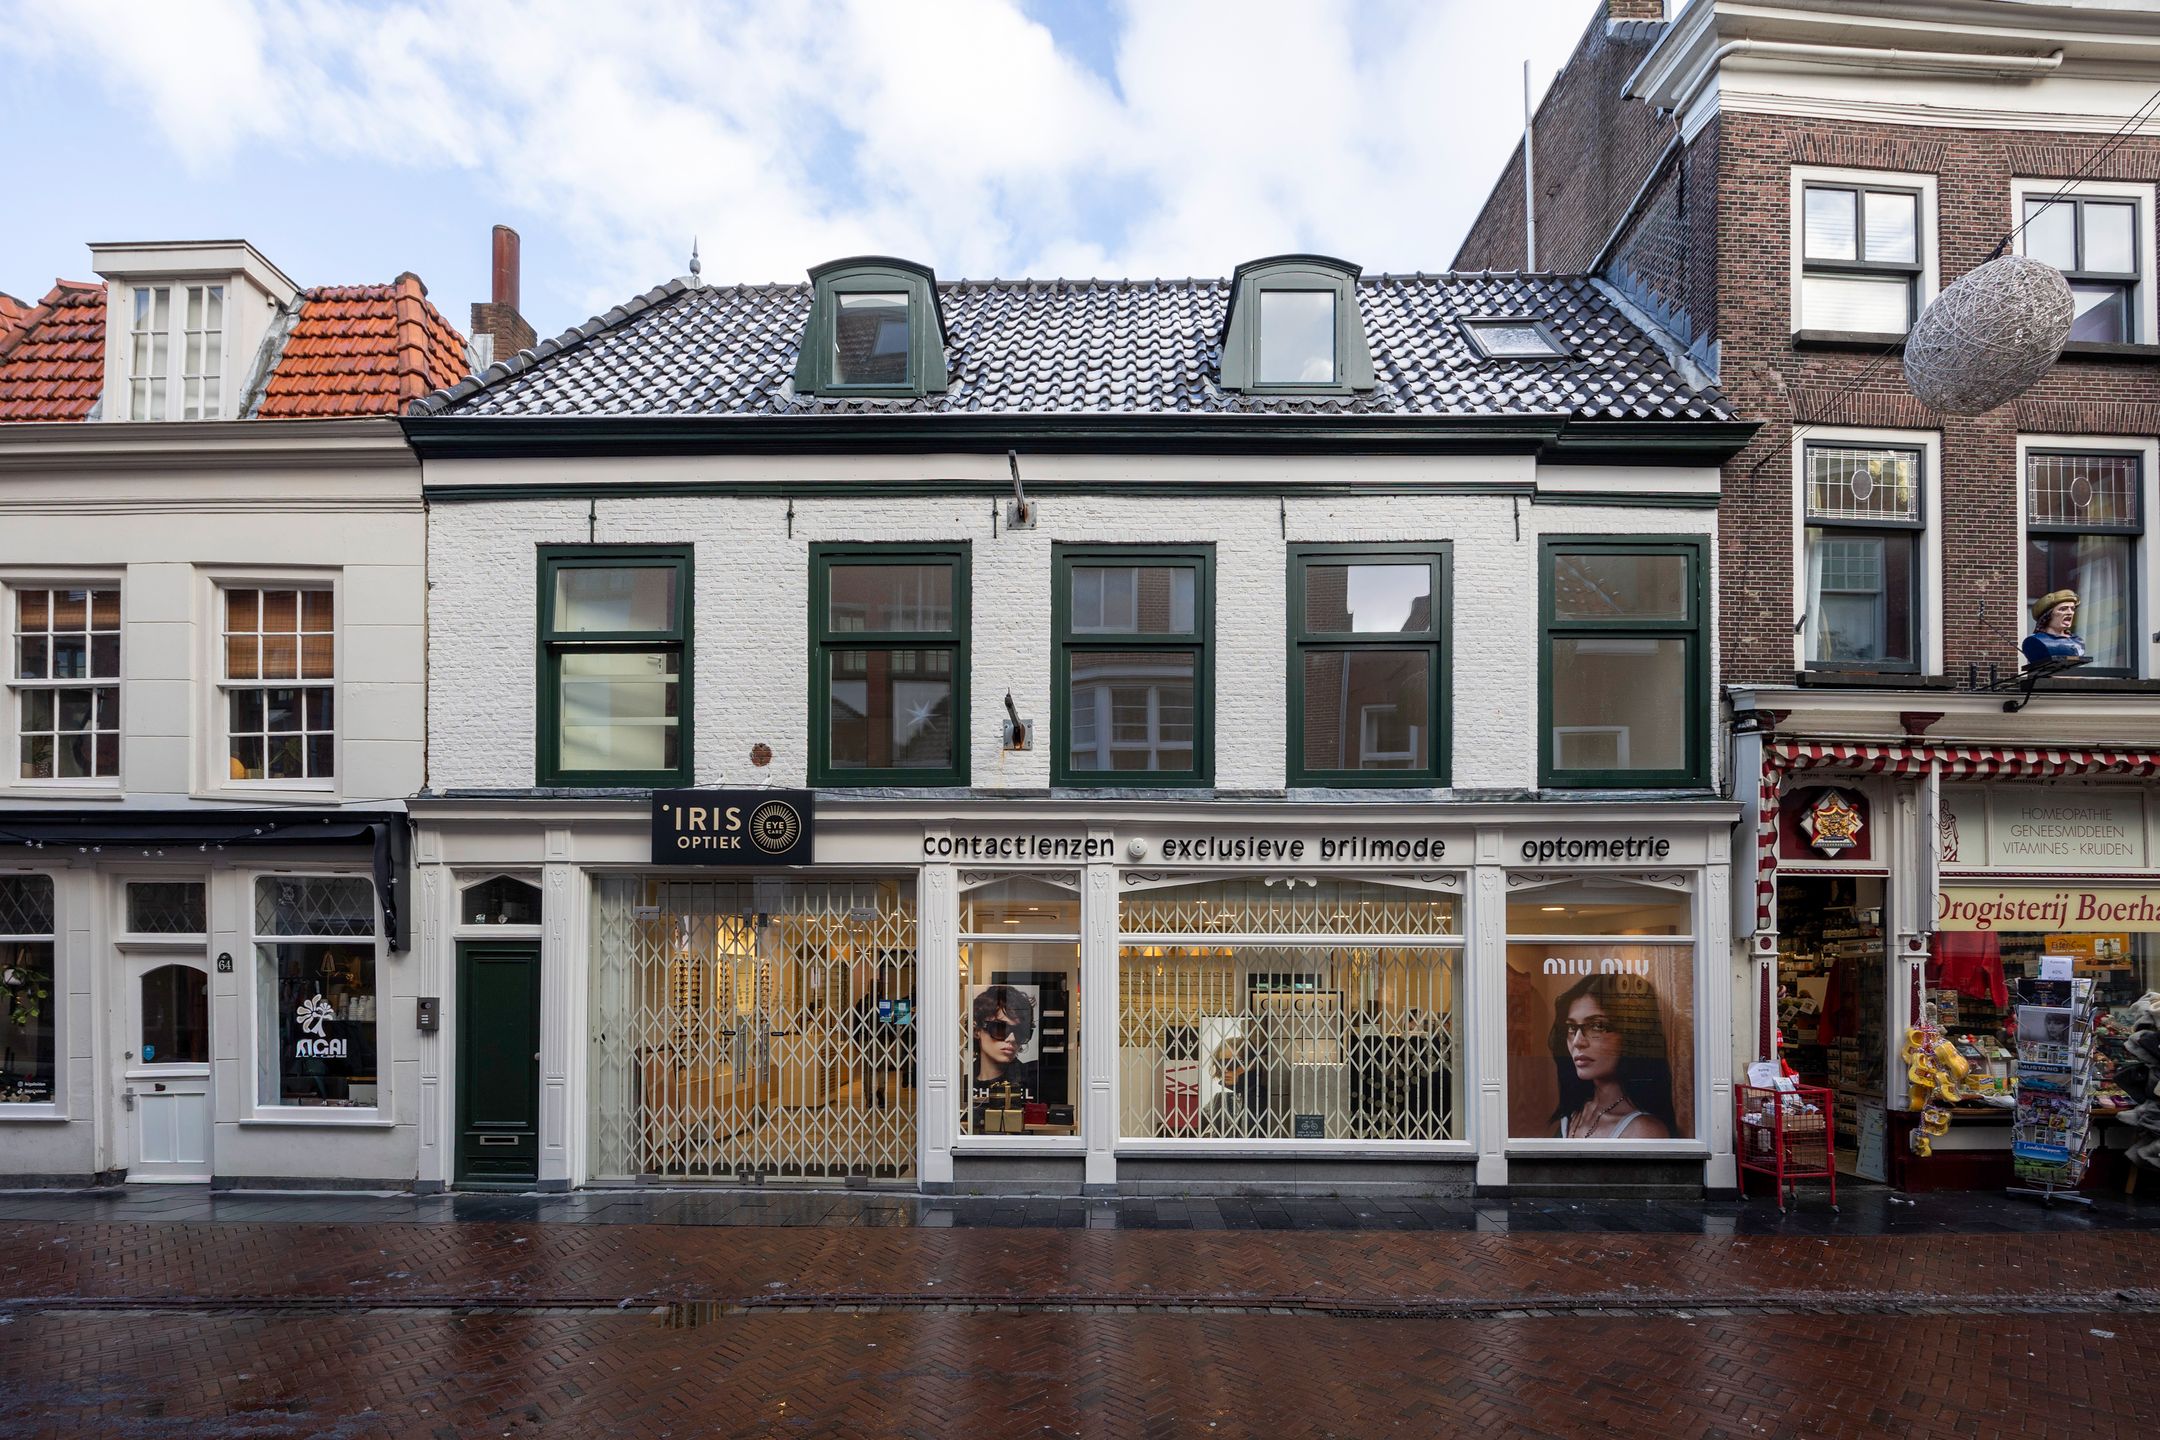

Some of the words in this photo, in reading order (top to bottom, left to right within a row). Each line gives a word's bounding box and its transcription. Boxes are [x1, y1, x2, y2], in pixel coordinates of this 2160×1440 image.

[675, 806, 742, 831] IRIS
[2021, 807, 2113, 821] HOMEOPATHIE
[766, 821, 785, 829] EYE
[2010, 824, 2125, 838] GENEESMIDDELEN
[677, 836, 742, 849] OPTIEK
[923, 835, 1114, 856] contactlenzen
[1162, 836, 1305, 857] exclusieve
[1321, 836, 1446, 858] brilmode
[1521, 836, 1670, 862] optometrie
[2002, 841, 2069, 855] VITAMINES
[2079, 842, 2134, 856] KRUIDEN
[218, 960, 232, 971] 64
[2019, 1064, 2059, 1073] MUSTANG
[972, 1087, 1034, 1100] CHL
